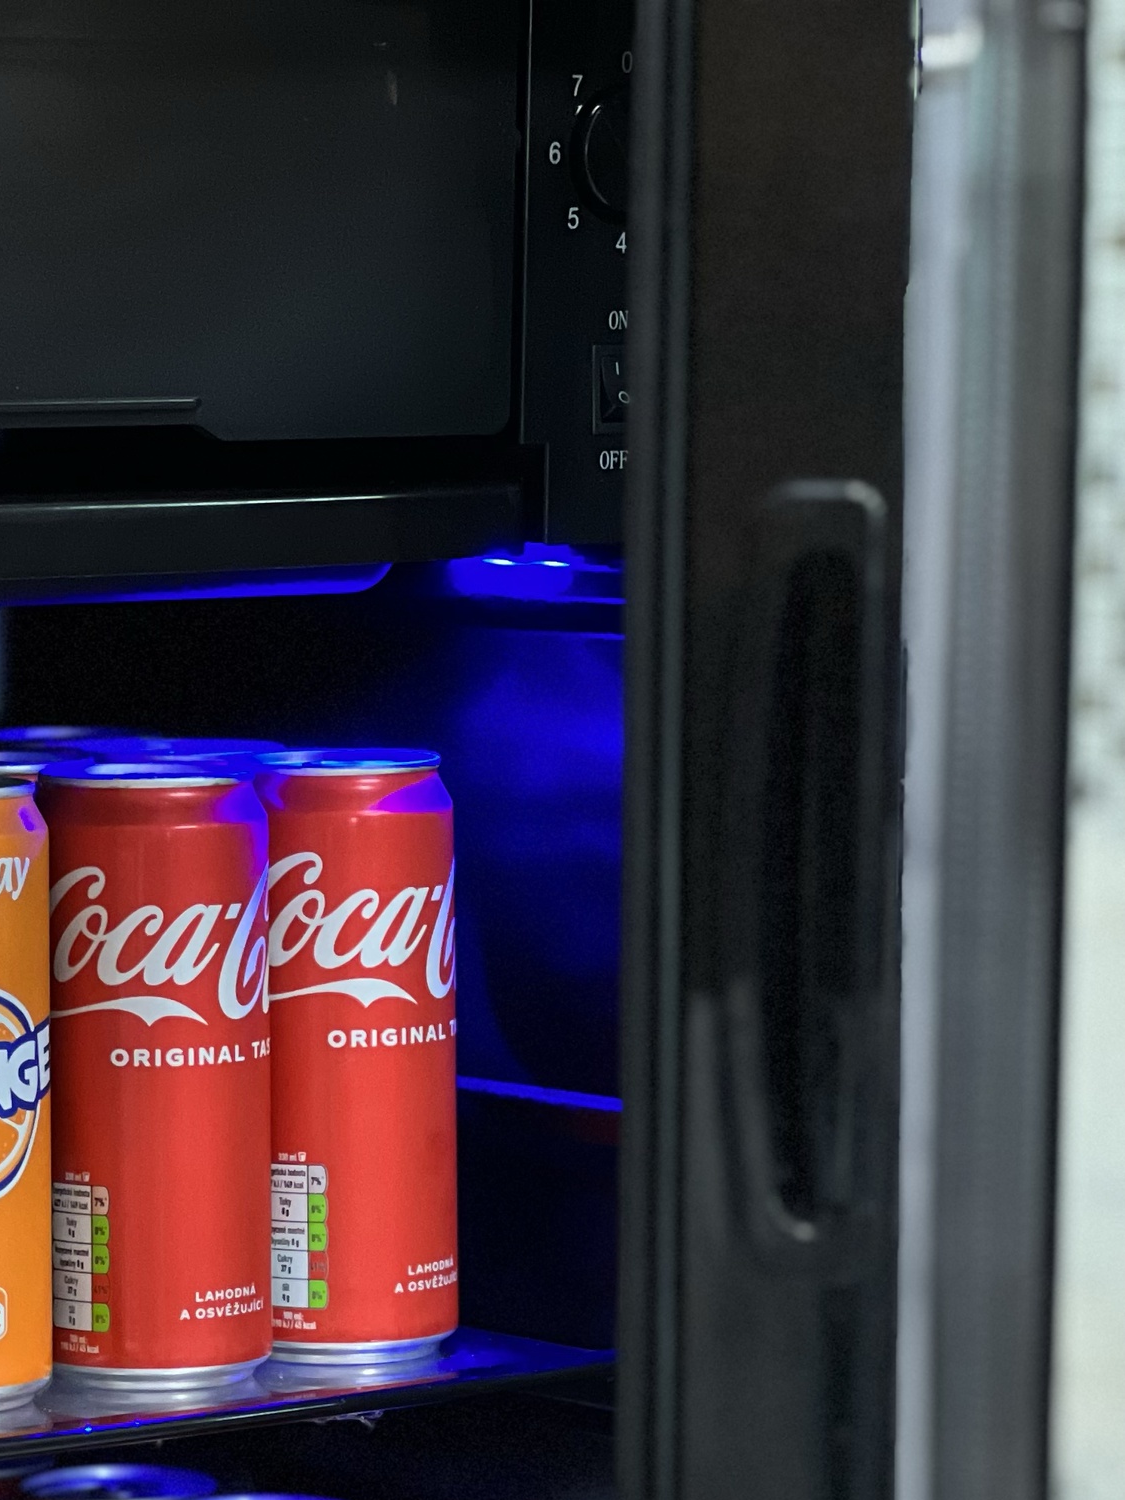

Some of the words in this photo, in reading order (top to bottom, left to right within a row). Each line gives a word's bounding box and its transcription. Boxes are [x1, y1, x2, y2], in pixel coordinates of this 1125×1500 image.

[572, 74, 583, 97] 7
[549, 141, 561, 165] 6
[567, 207, 579, 229] 5
[615, 232, 627, 254] 4
[608, 310, 629, 330] ON
[599, 450, 628, 470] OFF
[327, 1023, 446, 1048] ORIGINAL
[110, 1044, 245, 1067] ORIGINAL
[195, 1282, 256, 1303] LAHODNÁ
[394, 1282, 404, 1294] A
[180, 1309, 190, 1320] A
